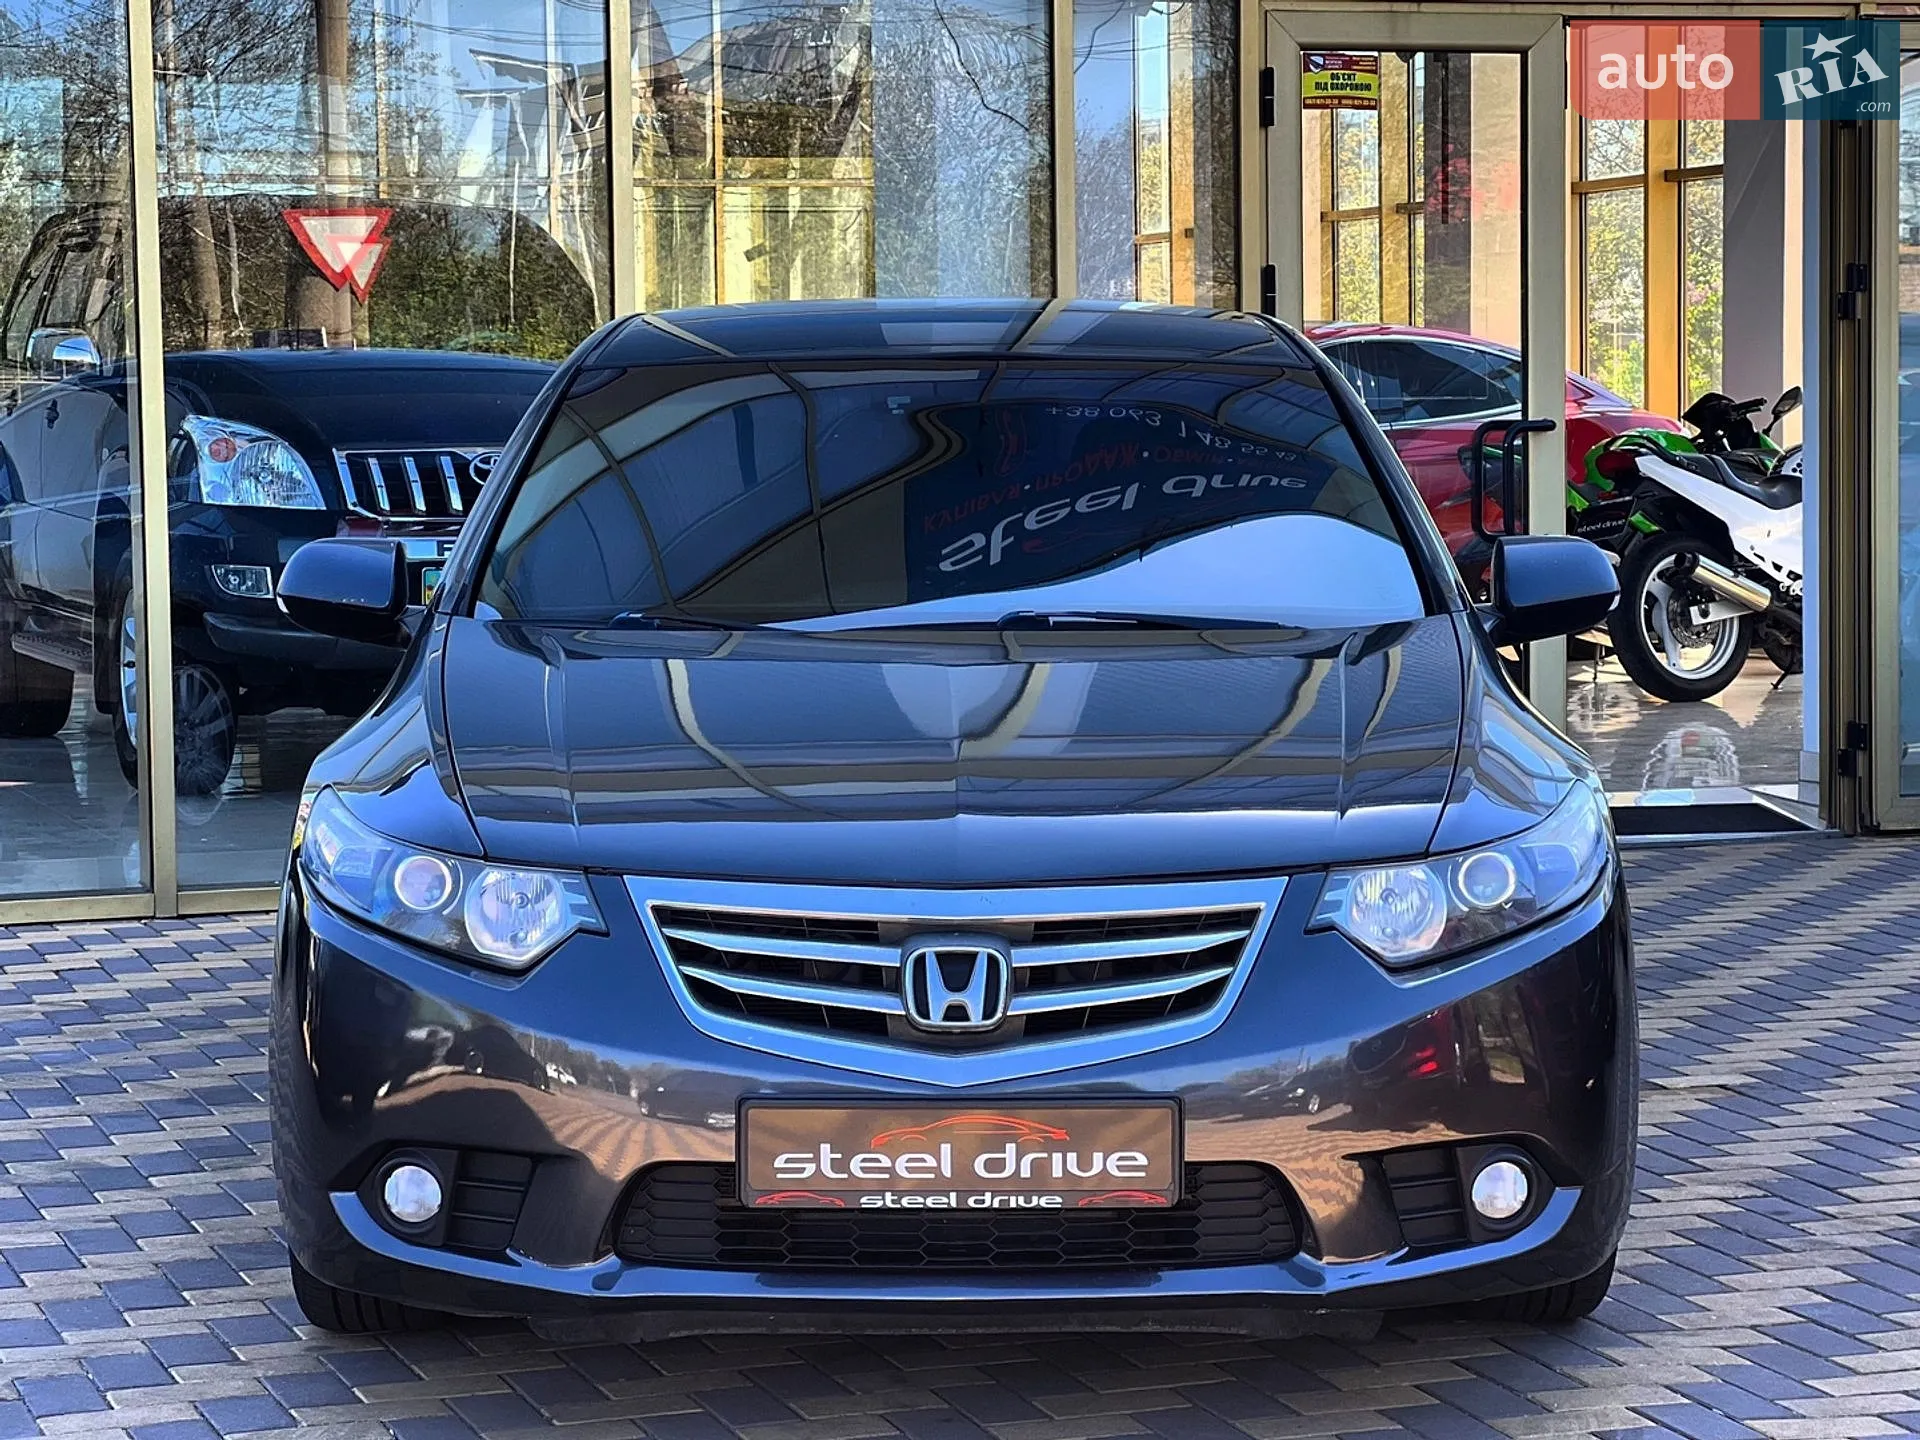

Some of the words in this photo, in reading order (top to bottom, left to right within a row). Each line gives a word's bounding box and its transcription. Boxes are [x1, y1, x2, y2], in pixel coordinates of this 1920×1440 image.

[1314, 82, 1329, 92] ПІД
[772, 1143, 952, 1180] steel
[973, 1142, 1149, 1179] drive
[859, 1191, 957, 1209] steel
[967, 1191, 1063, 1209] drive
